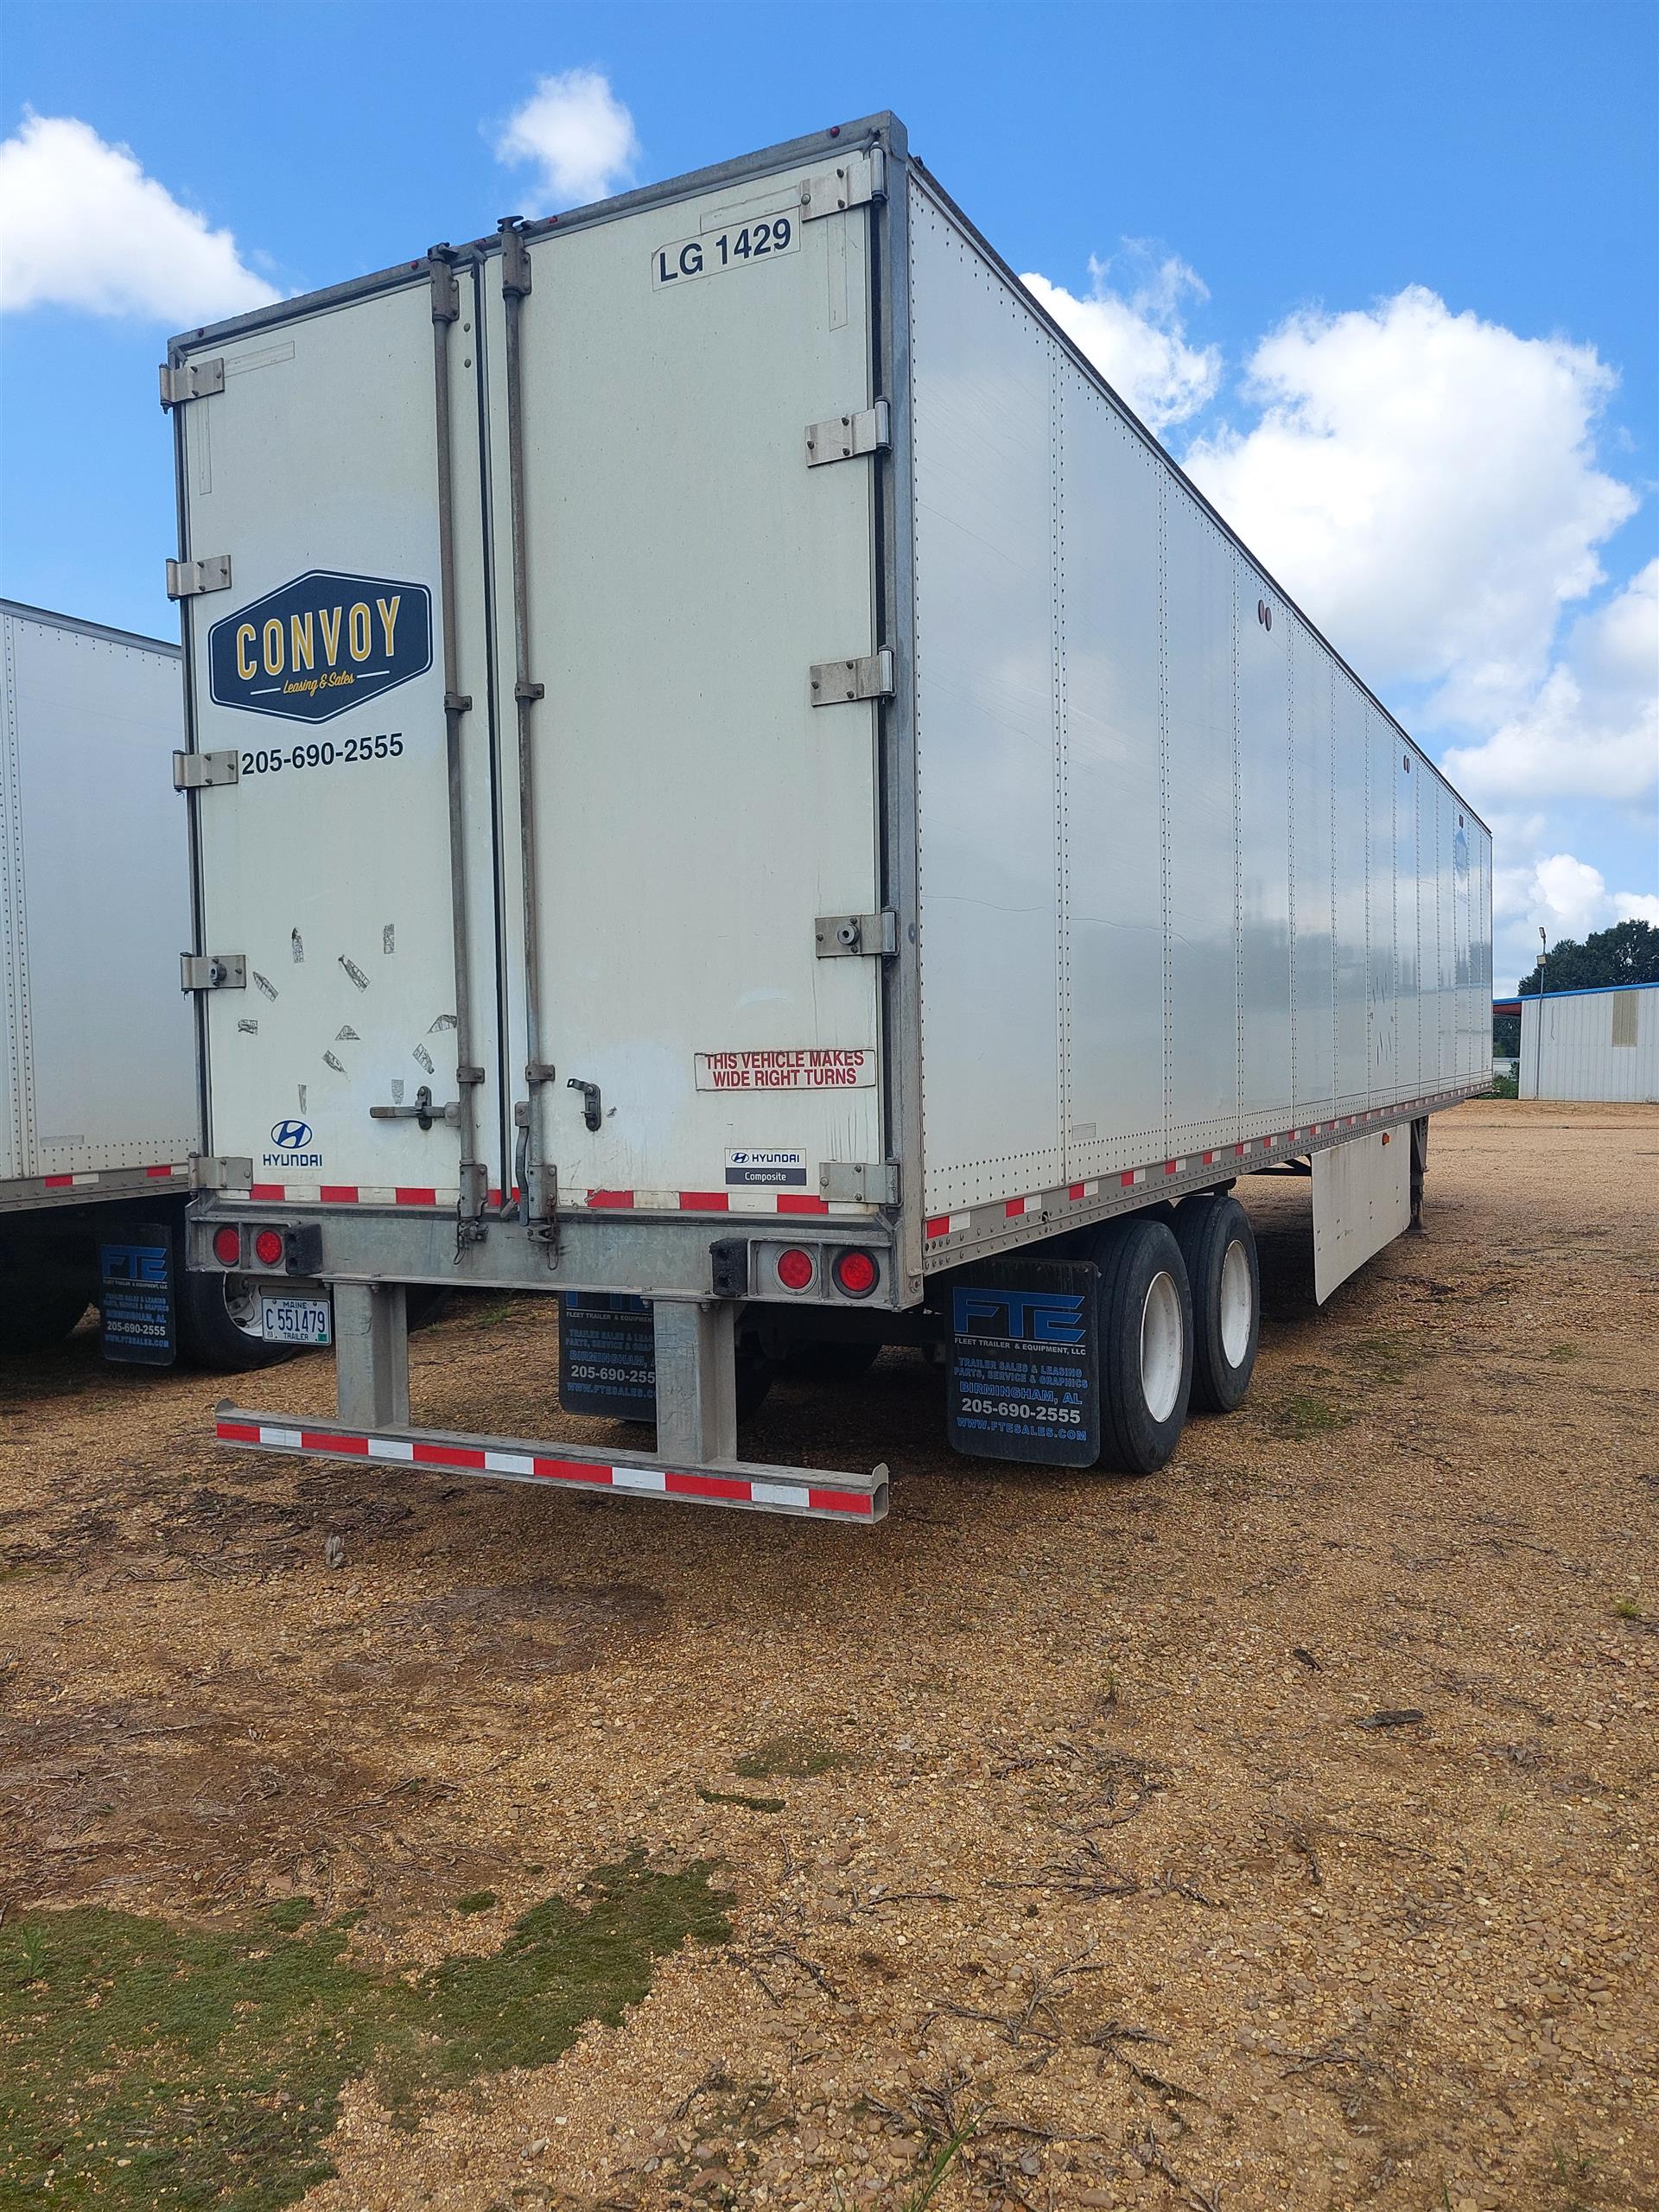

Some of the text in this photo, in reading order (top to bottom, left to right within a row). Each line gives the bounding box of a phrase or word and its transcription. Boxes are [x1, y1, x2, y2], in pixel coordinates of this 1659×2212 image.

[659, 218, 791, 282] LG 1429
[236, 595, 401, 681] CONVOY
[283, 678, 318, 697] Leasing
[241, 733, 404, 775] 205-690-2555
[705, 1051, 864, 1070] THIS VEHICLE MAKES
[713, 1068, 857, 1087] WIDE RIGHT TURNS
[263, 1154, 322, 1166] HYUNDAI
[752, 1154, 800, 1163] HYUNDAI
[745, 1172, 786, 1182] Composite
[101, 1244, 167, 1281] FTE
[266, 1308, 326, 1333] C 551479
[953, 1287, 1086, 1343] FTE
[107, 1320, 166, 1336] 205-690-2555
[283, 1332, 309, 1341] TRAILER
[979, 1339, 1011, 1349] TRAILER
[1022, 1344, 1070, 1356] EQUIPMENT,
[571, 1365, 656, 1383] 205-690-255
[958, 1357, 1083, 1377] TRAILER SALES & LEASING
[954, 1367, 1089, 1389] PARTS, SERVICE & GRAPHICS
[959, 1381, 1083, 1405] BIRMINGHAM, AL
[962, 1397, 1081, 1424] 205-690-2555
[957, 1416, 1087, 1441] WWW.FTESALES.COM
